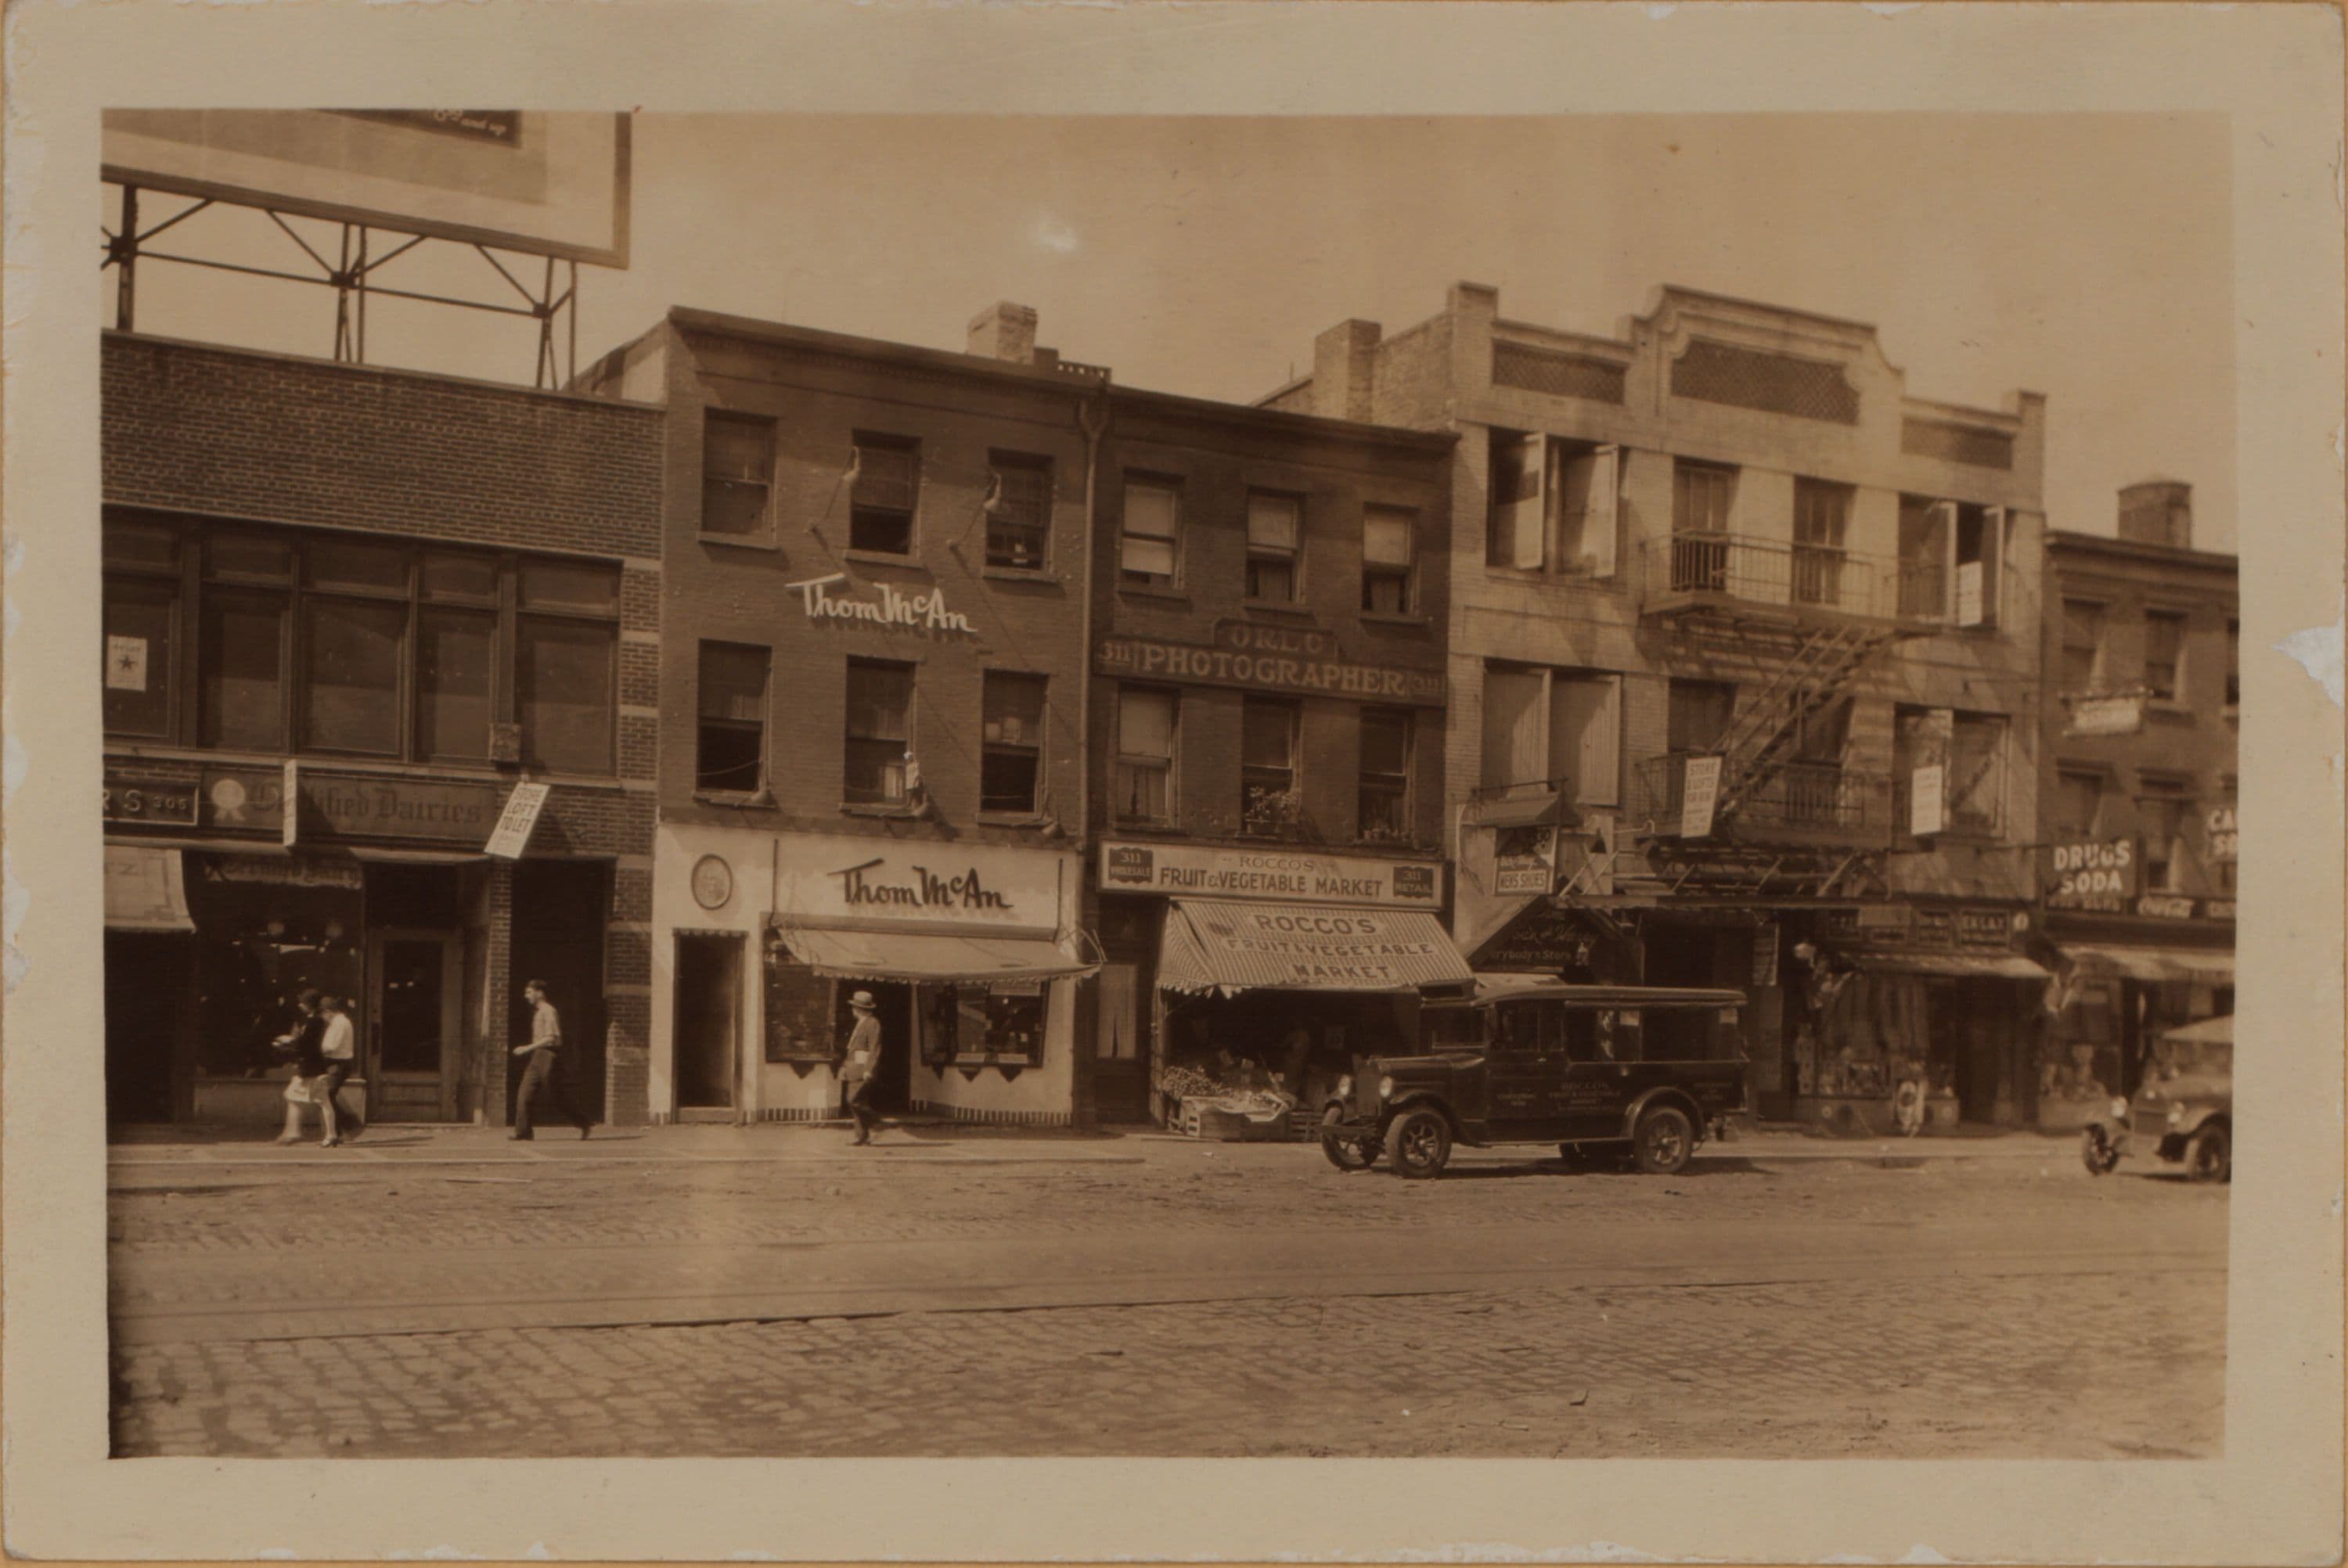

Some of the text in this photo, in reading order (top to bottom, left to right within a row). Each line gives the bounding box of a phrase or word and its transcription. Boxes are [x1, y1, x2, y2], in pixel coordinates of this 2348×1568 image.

[785, 572, 887, 624] Thom
[1099, 641, 1130, 664] 311
[1142, 644, 1406, 697] PHOTOGRAPHER
[1119, 851, 1141, 864] 311
[2053, 840, 2131, 871] DRUGS
[826, 857, 923, 908] Thom
[1160, 867, 1208, 888] FRUIT
[1218, 871, 1307, 894] VEGETABLE
[1315, 878, 1383, 897] MARKET
[1402, 870, 1421, 882] 311
[2060, 870, 2123, 894] SODA
[1252, 914, 1376, 935] ROCCO'S
[1291, 963, 1388, 979] MARKET
